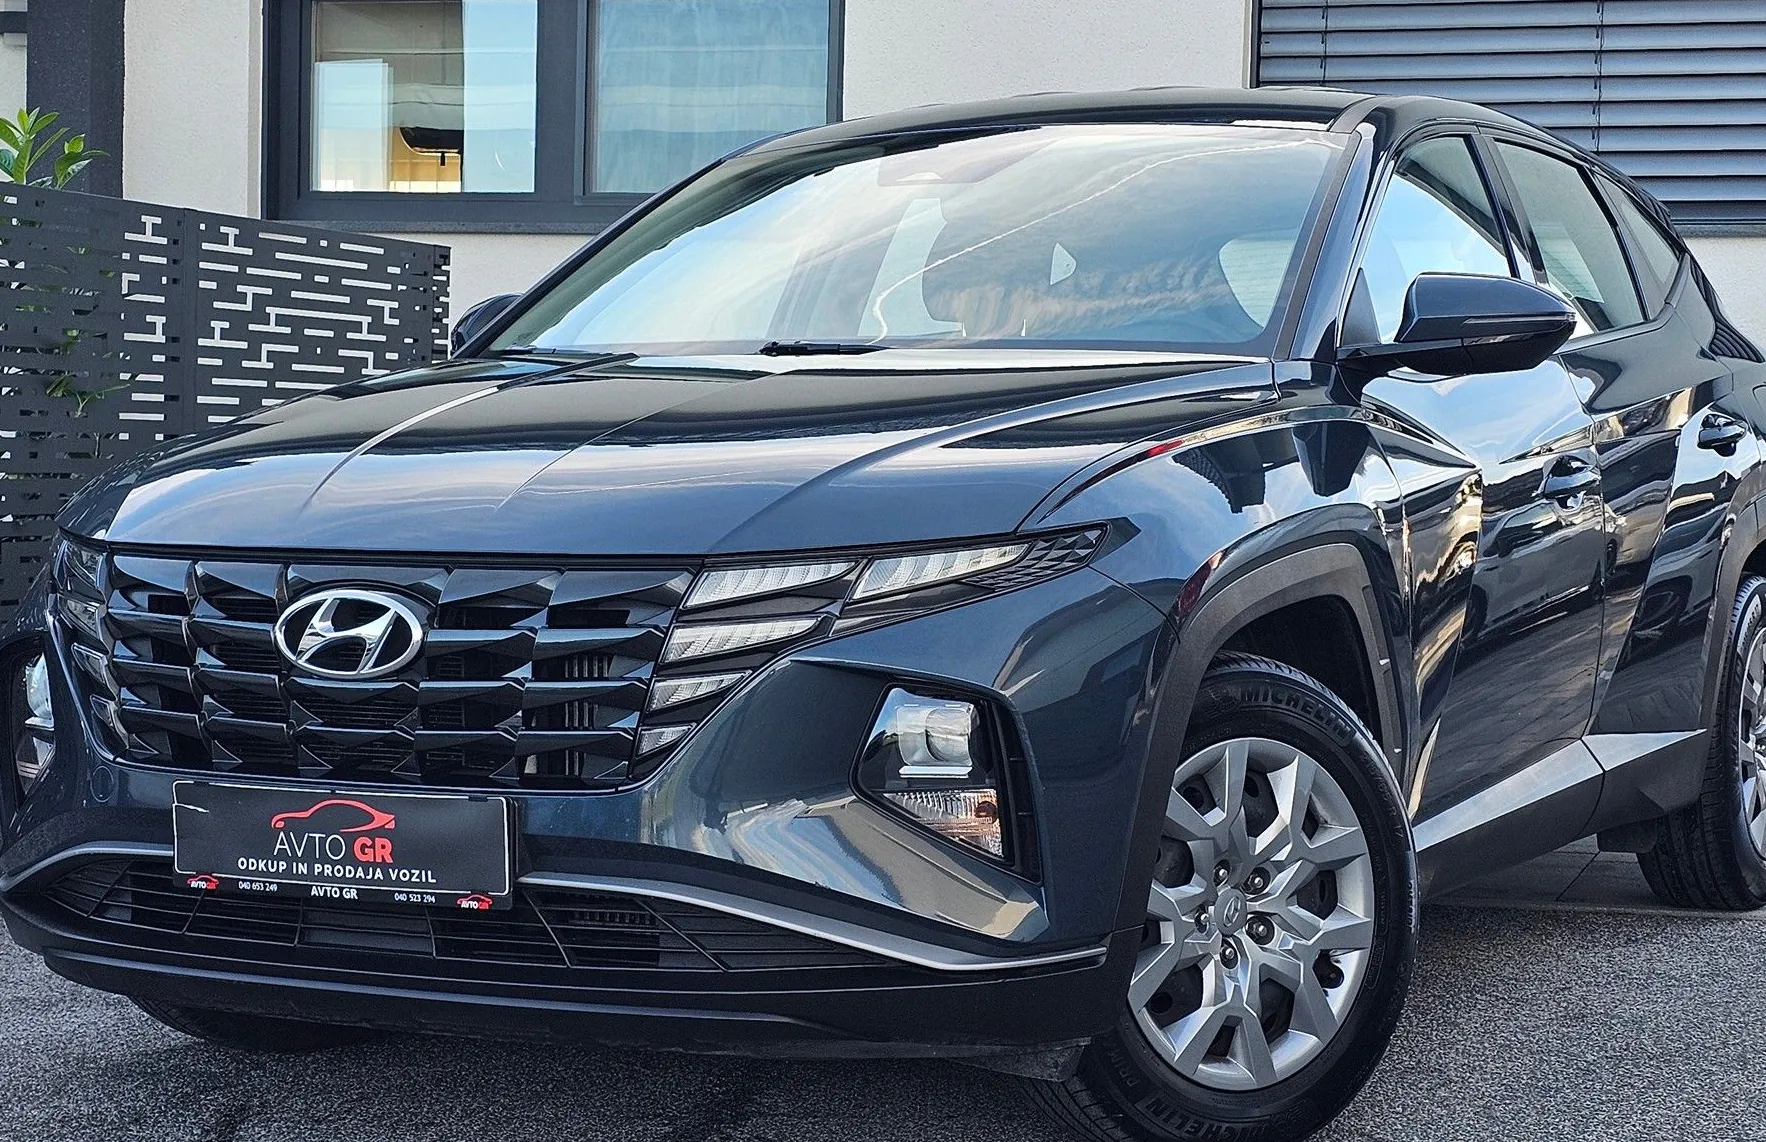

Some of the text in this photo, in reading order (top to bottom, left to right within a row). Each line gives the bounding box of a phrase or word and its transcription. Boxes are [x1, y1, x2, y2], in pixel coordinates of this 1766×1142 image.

[1240, 684, 1353, 740] MICHELIN
[273, 831, 394, 863] AVTO GR
[237, 857, 437, 883] ODKUP IN PRODAJA VOZIL
[238, 880, 278, 892] 040 653 249
[310, 885, 359, 900] AVTO GR
[394, 892, 436, 904] 040 523 294
